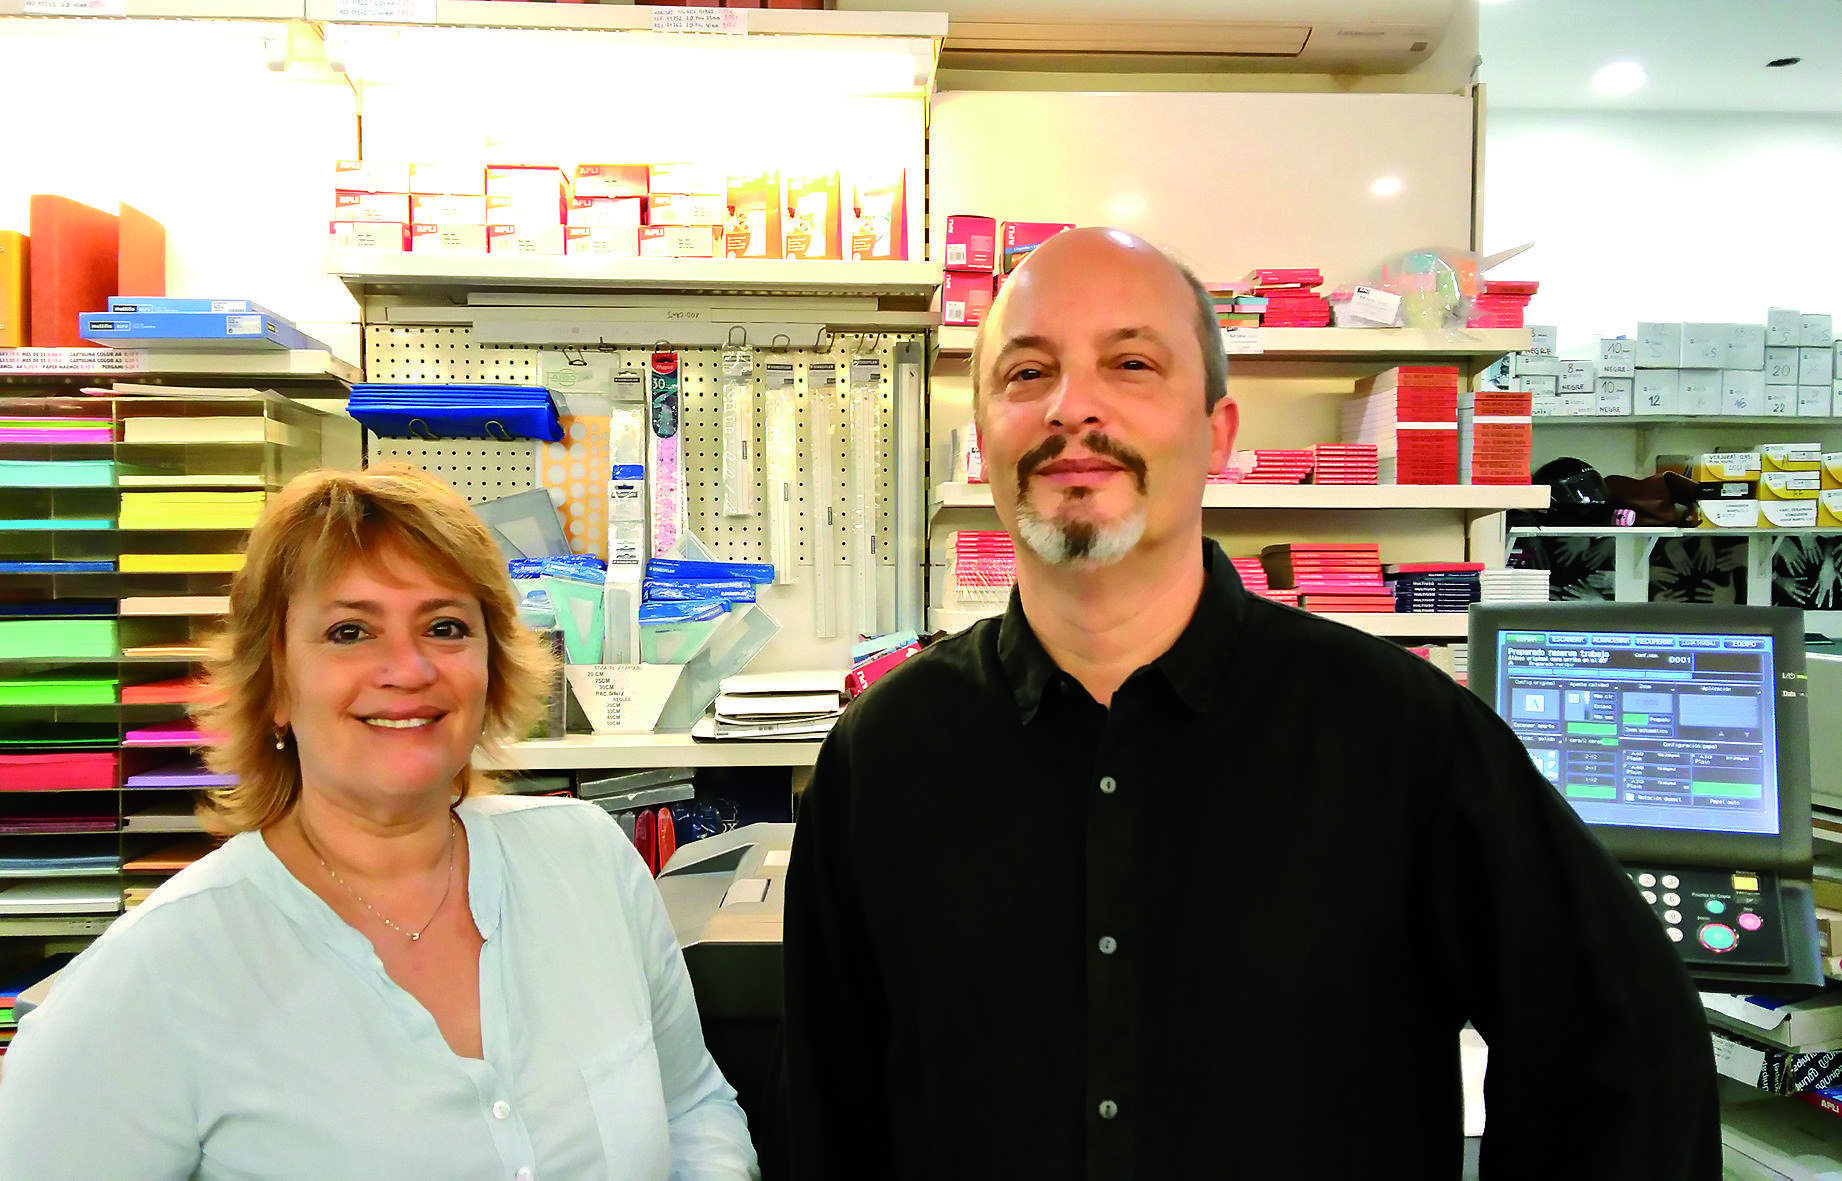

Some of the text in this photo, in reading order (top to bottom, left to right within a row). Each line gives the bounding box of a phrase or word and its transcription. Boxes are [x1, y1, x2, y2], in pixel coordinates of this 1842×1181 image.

[417, 225, 437, 233] APLI
[494, 226, 514, 234] APLI
[645, 228, 664, 236] APLI
[1608, 343, 1622, 354] 10
[1773, 365, 1790, 376] 20
[653, 379, 665, 390] 30
[1602, 382, 1615, 393] 10
[1648, 395, 1660, 407] 12
[1773, 403, 1784, 413] 22
[1508, 648, 1545, 657] Preparado
[1580, 650, 1610, 659] trabajo
[1821, 1100, 1840, 1114] APLI
